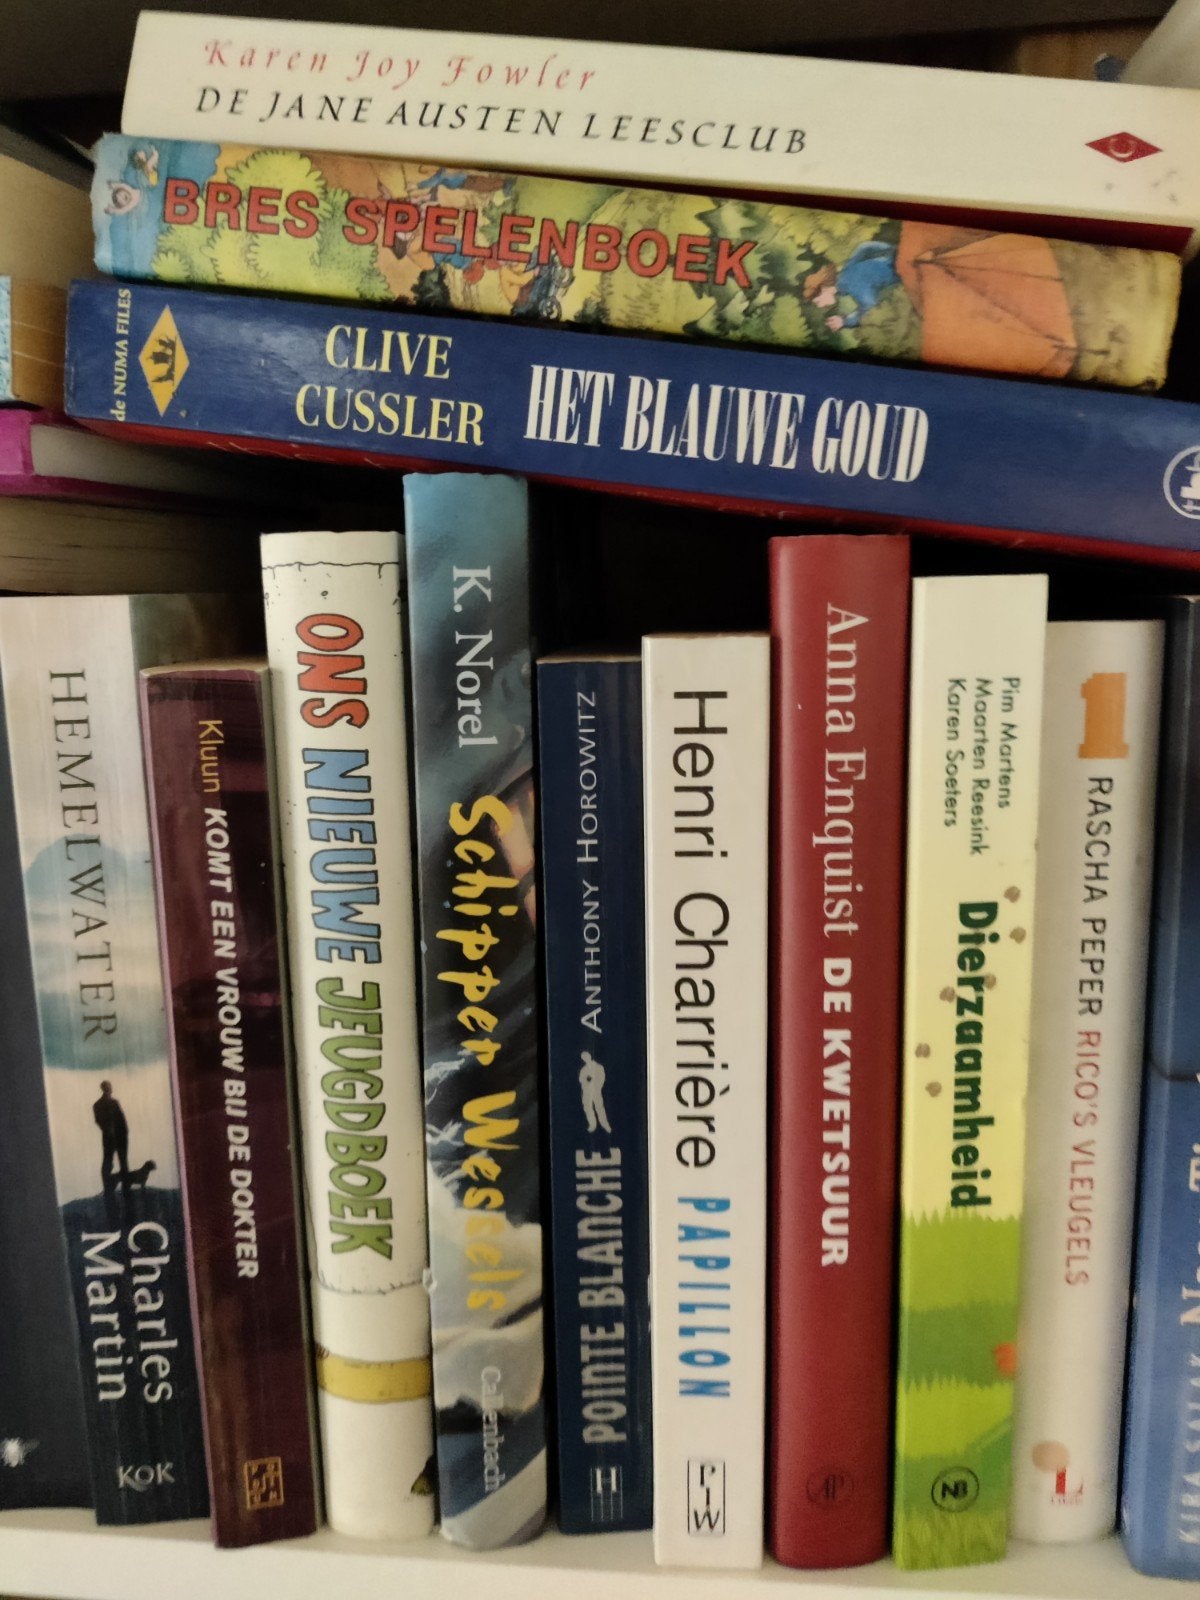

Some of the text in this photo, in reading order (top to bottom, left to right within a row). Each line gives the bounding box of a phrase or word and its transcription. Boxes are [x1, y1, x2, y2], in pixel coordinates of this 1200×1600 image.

[196, 86, 807, 154] DE JANE AUSTEN LEESCLUB
[204, 38, 598, 92] Karen Joy Fowler
[164, 177, 758, 290] BRES SPELENBOEK
[110, 288, 132, 422] de NUMA FILES
[296, 384, 484, 447] CUSSLER
[325, 324, 452, 380] CLIVE
[523, 364, 929, 483] HET BLAUWE GOUD
[452, 565, 498, 749] K. Norel
[997, 677, 1021, 809] Pim Martens
[943, 678, 967, 828] Karen Soeters
[970, 678, 993, 855] Maarten Reesink
[49, 668, 118, 1043] HEMELWATER
[295, 613, 393, 1261] ONS NIEUWE JEUGDBOEK
[576, 691, 602, 1034] ANTHONY HOROWITZ
[812, 602, 869, 1266] Anna Enquist DE KWETSUUR
[198, 719, 259, 1279] Kluun KOMT EEN VROUW BIJ DE DOKTER
[436, 794, 523, 1312] Schipper Wessels
[672, 690, 731, 1398] Henri Charrière PAPILLON
[950, 901, 999, 1208] Dierzaamheid
[1064, 776, 1113, 1286] RASCHA PEPER RICO'S VLEUGELS
[81, 1230, 128, 1402] Martin
[127, 1221, 179, 1405] Charles
[575, 1148, 628, 1445] POINTE BLANCHE
[117, 1461, 176, 1492] KOK
